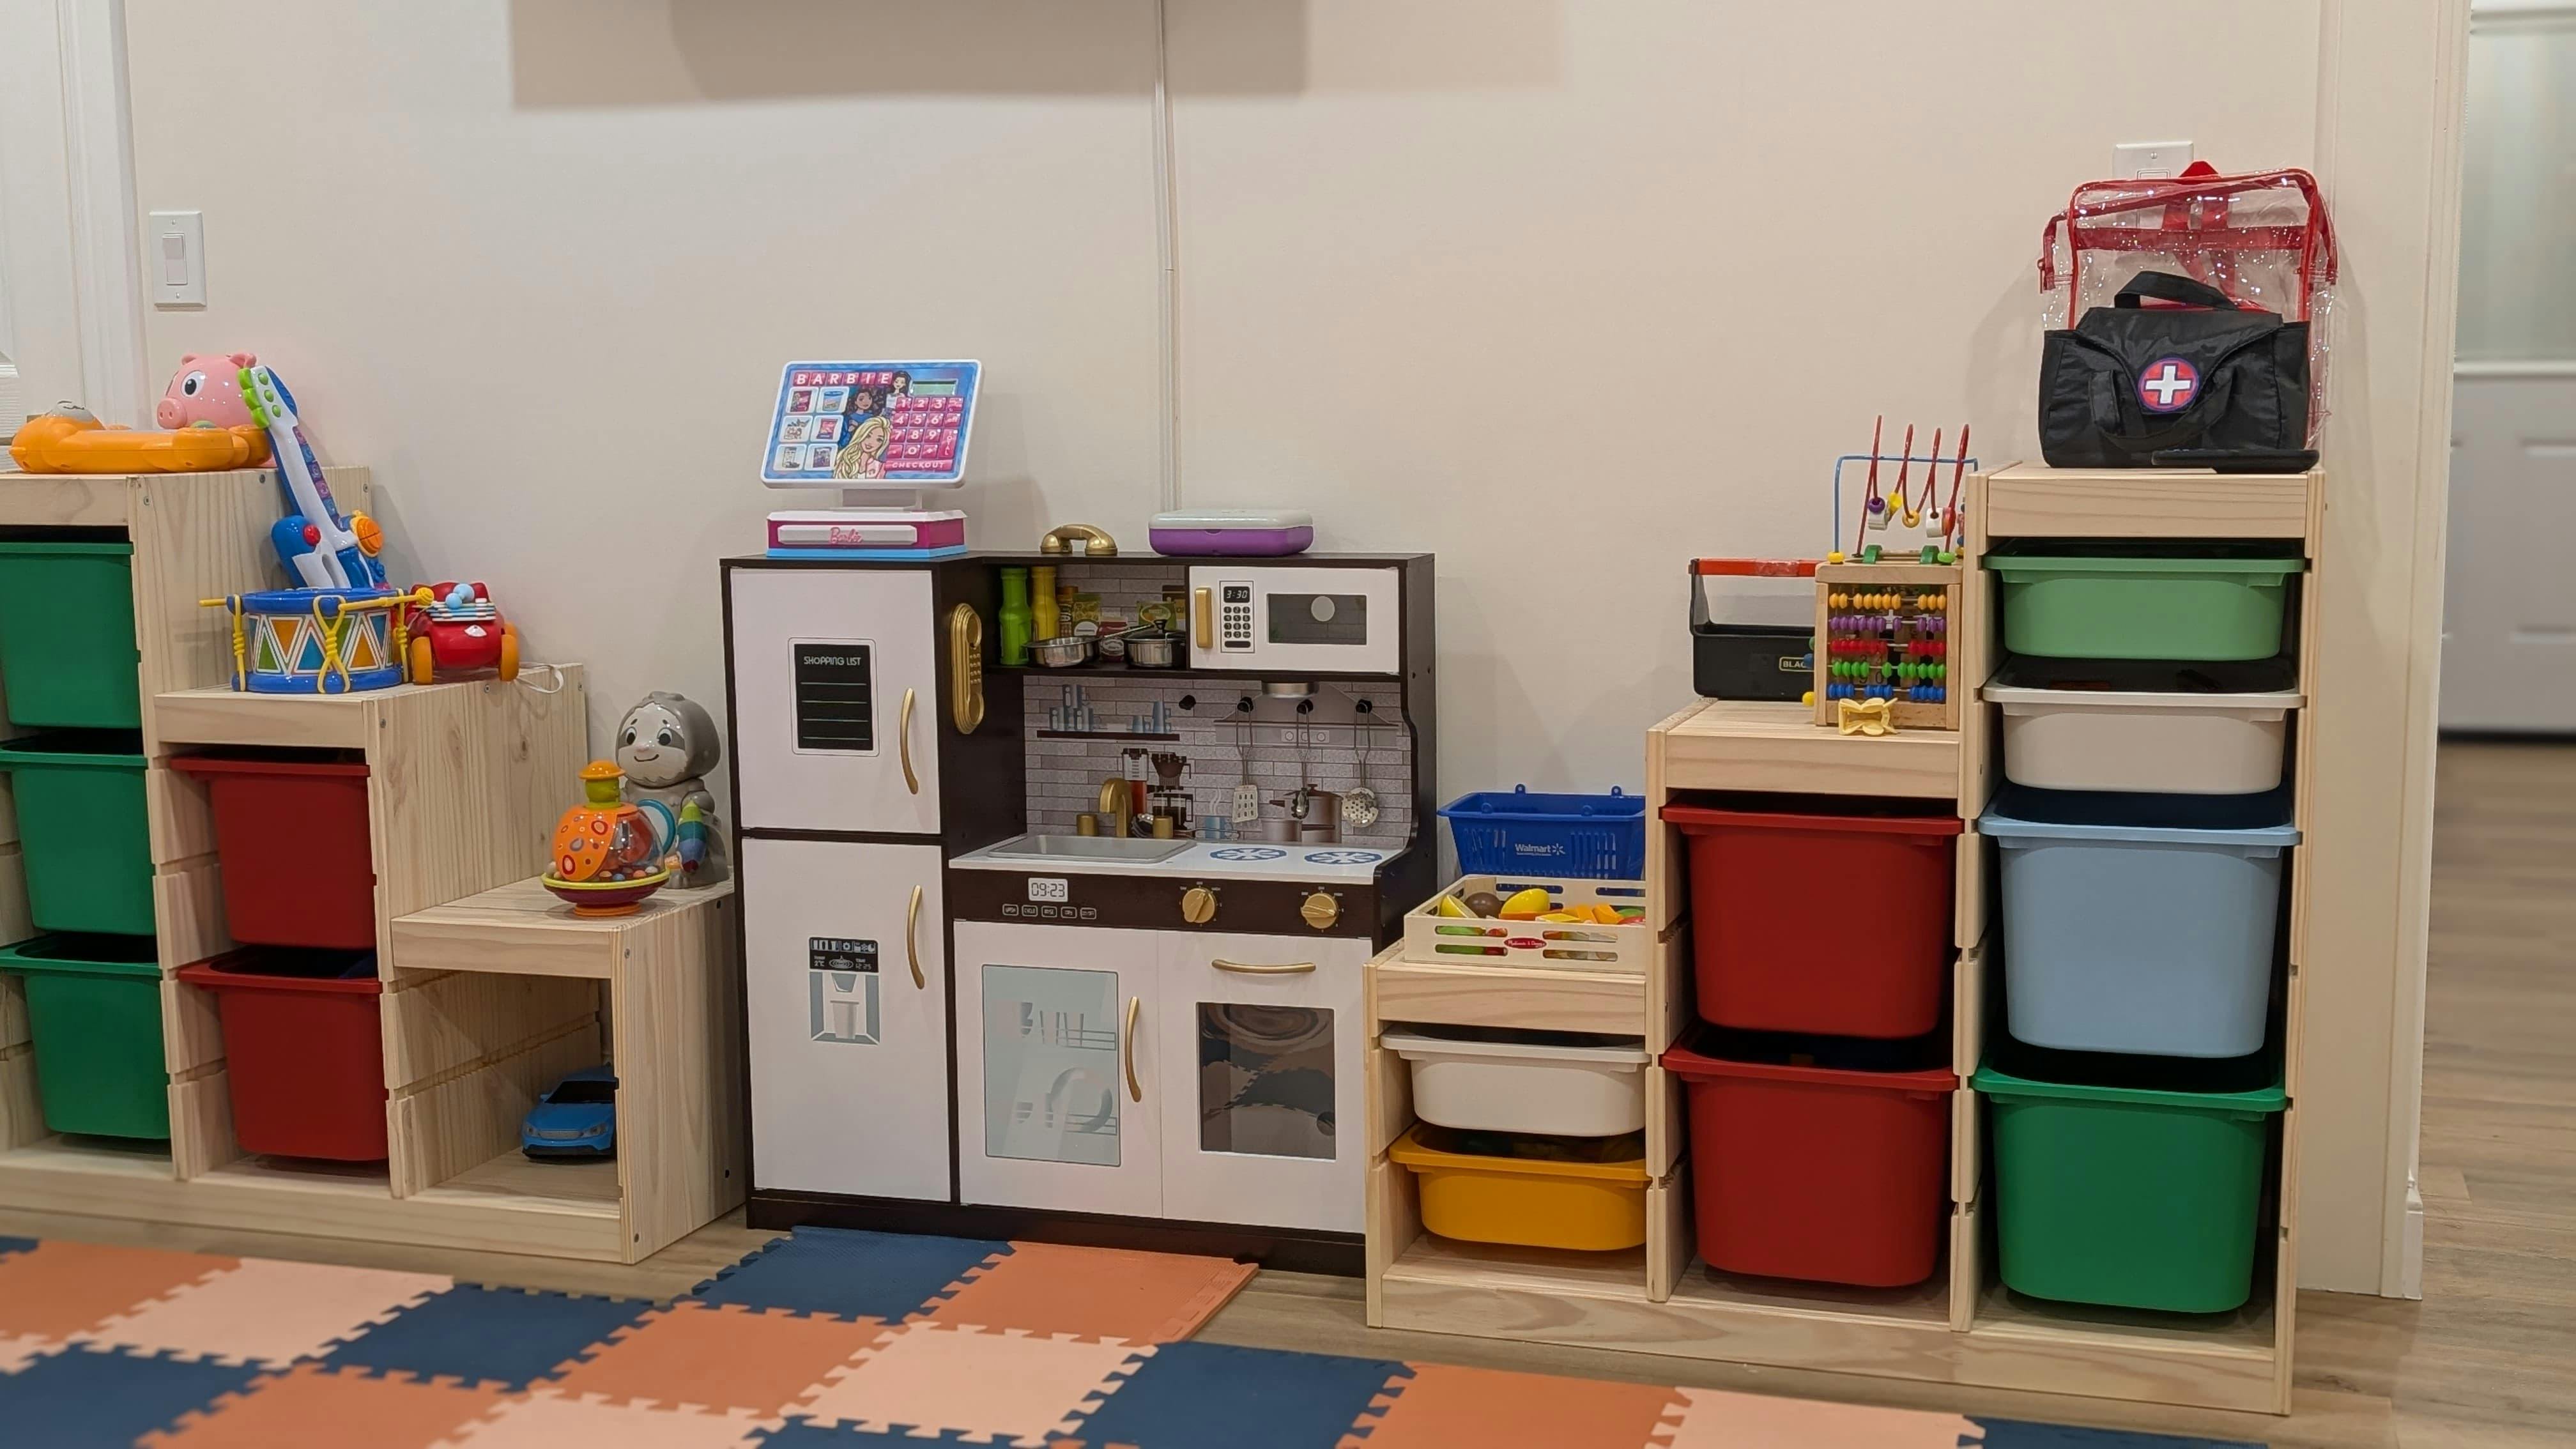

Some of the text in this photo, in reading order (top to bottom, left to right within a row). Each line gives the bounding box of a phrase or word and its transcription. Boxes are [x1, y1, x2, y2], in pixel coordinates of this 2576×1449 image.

[797, 372, 890, 385] BARBIE
[918, 399, 924, 408] 2
[934, 399, 942, 408] 3
[896, 416, 903, 424] 4
[914, 416, 922, 424] 5
[931, 415, 939, 424] 6
[895, 431, 937, 440] 7 8 9
[1226, 590, 1248, 599] 3:30
[804, 656, 862, 666] SHOPPING LIST
[1515, 843, 1551, 853] Walmart
[1031, 883, 1066, 898] 09:23
